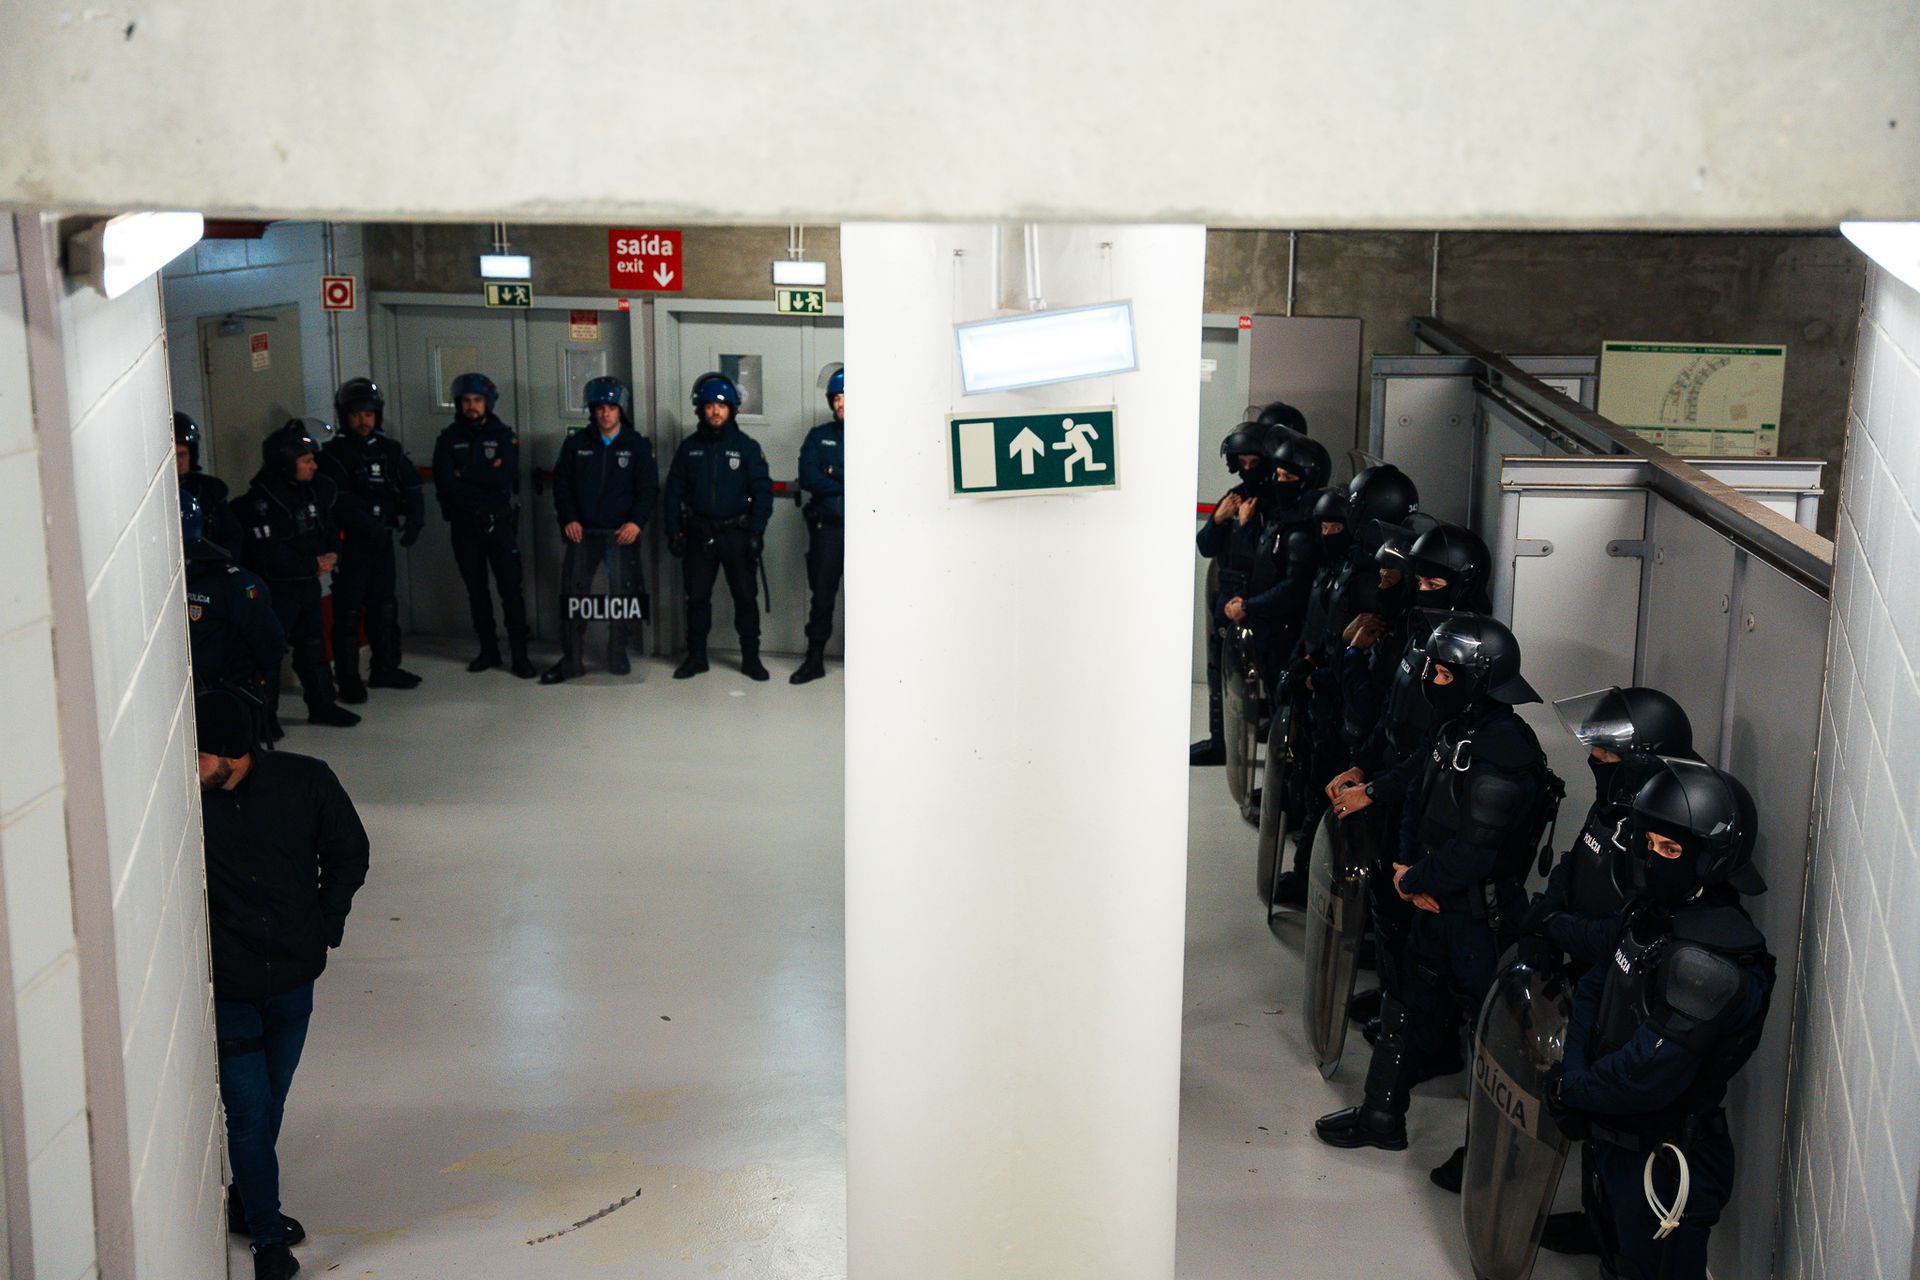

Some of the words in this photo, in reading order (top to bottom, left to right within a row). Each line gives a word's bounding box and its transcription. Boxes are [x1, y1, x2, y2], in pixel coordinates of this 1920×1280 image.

[616, 234, 673, 256] saída
[617, 258, 644, 273] exit
[568, 594, 642, 620] POLÍCIA
[1583, 832, 1601, 854] POLÍCIA
[1476, 1054, 1527, 1130] OLÍCIA
